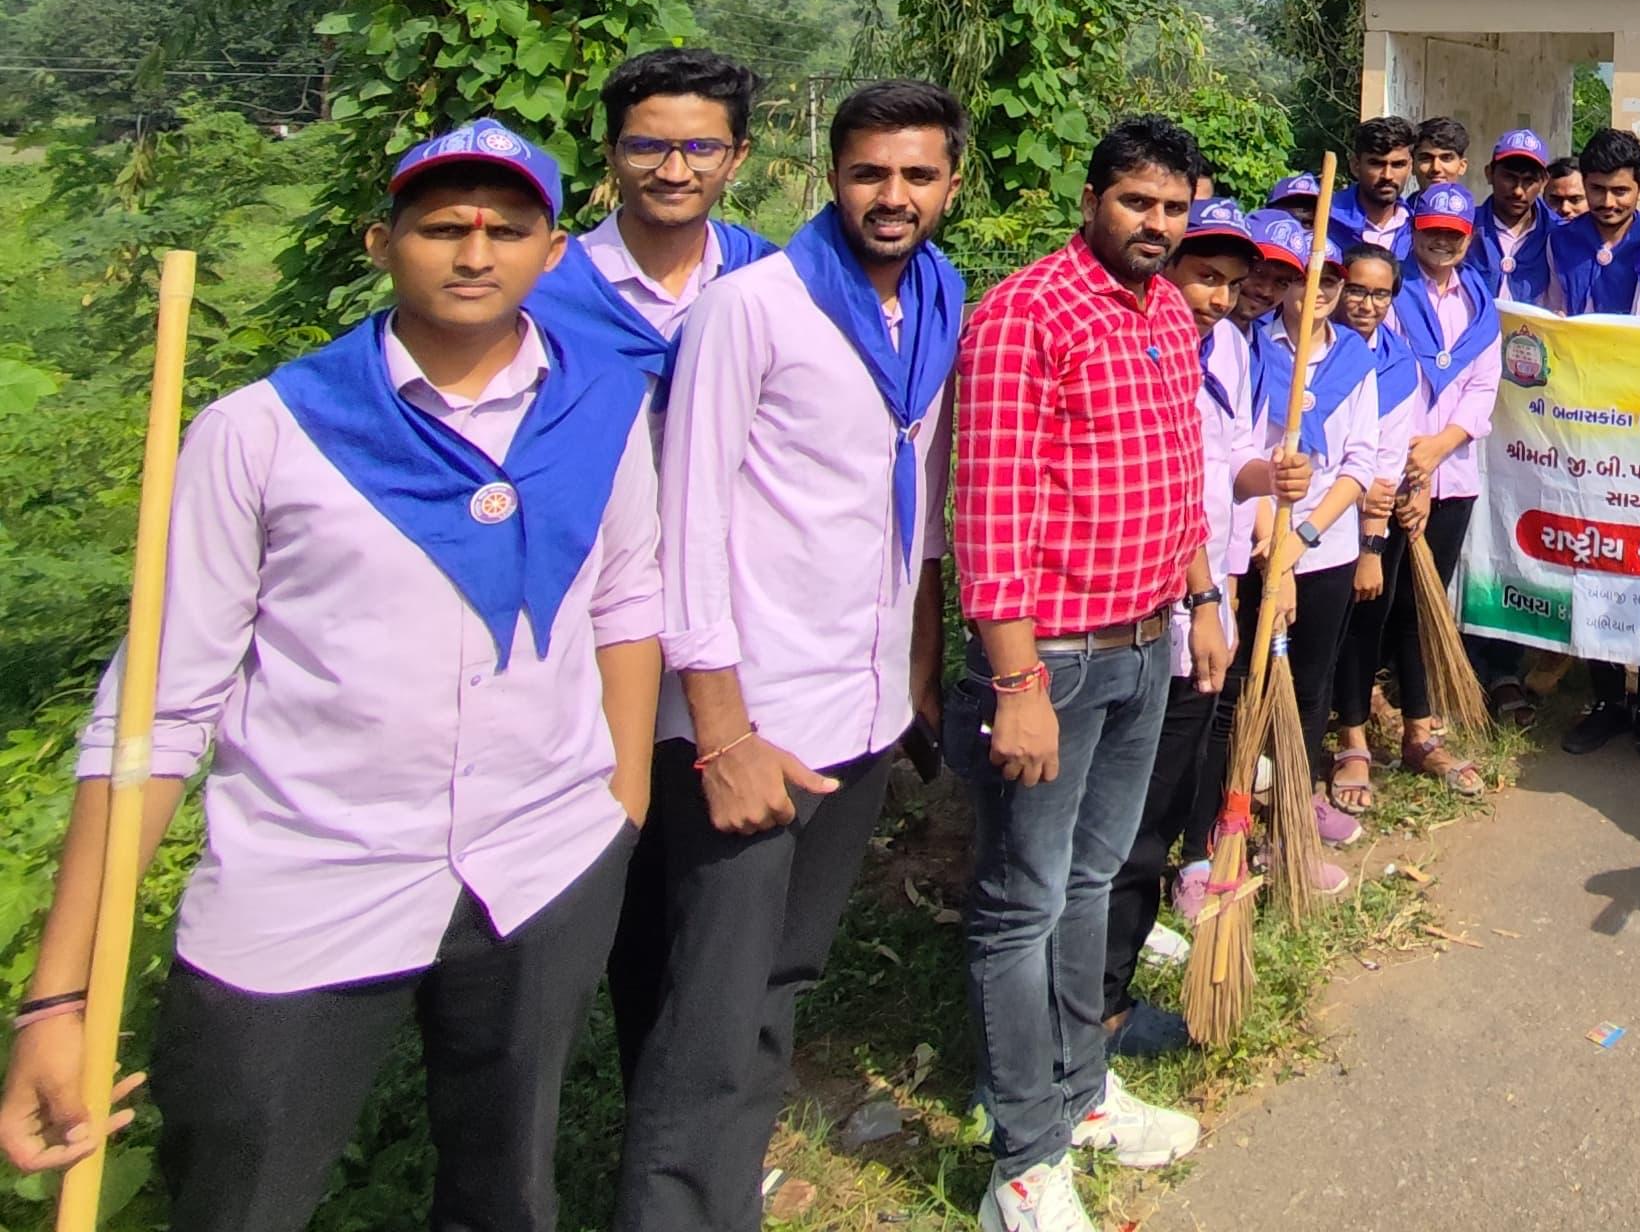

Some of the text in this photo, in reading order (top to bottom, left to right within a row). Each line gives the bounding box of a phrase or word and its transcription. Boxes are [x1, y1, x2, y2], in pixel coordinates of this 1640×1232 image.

[1529, 398, 1545, 417] શ્રી
[1552, 406, 1632, 427] બનાસકાંઠા
[1506, 441, 1558, 468] શ્રીમતી
[1541, 526, 1624, 564] રાષ્ટ્રીય
[1503, 585, 1551, 615] વિષય
